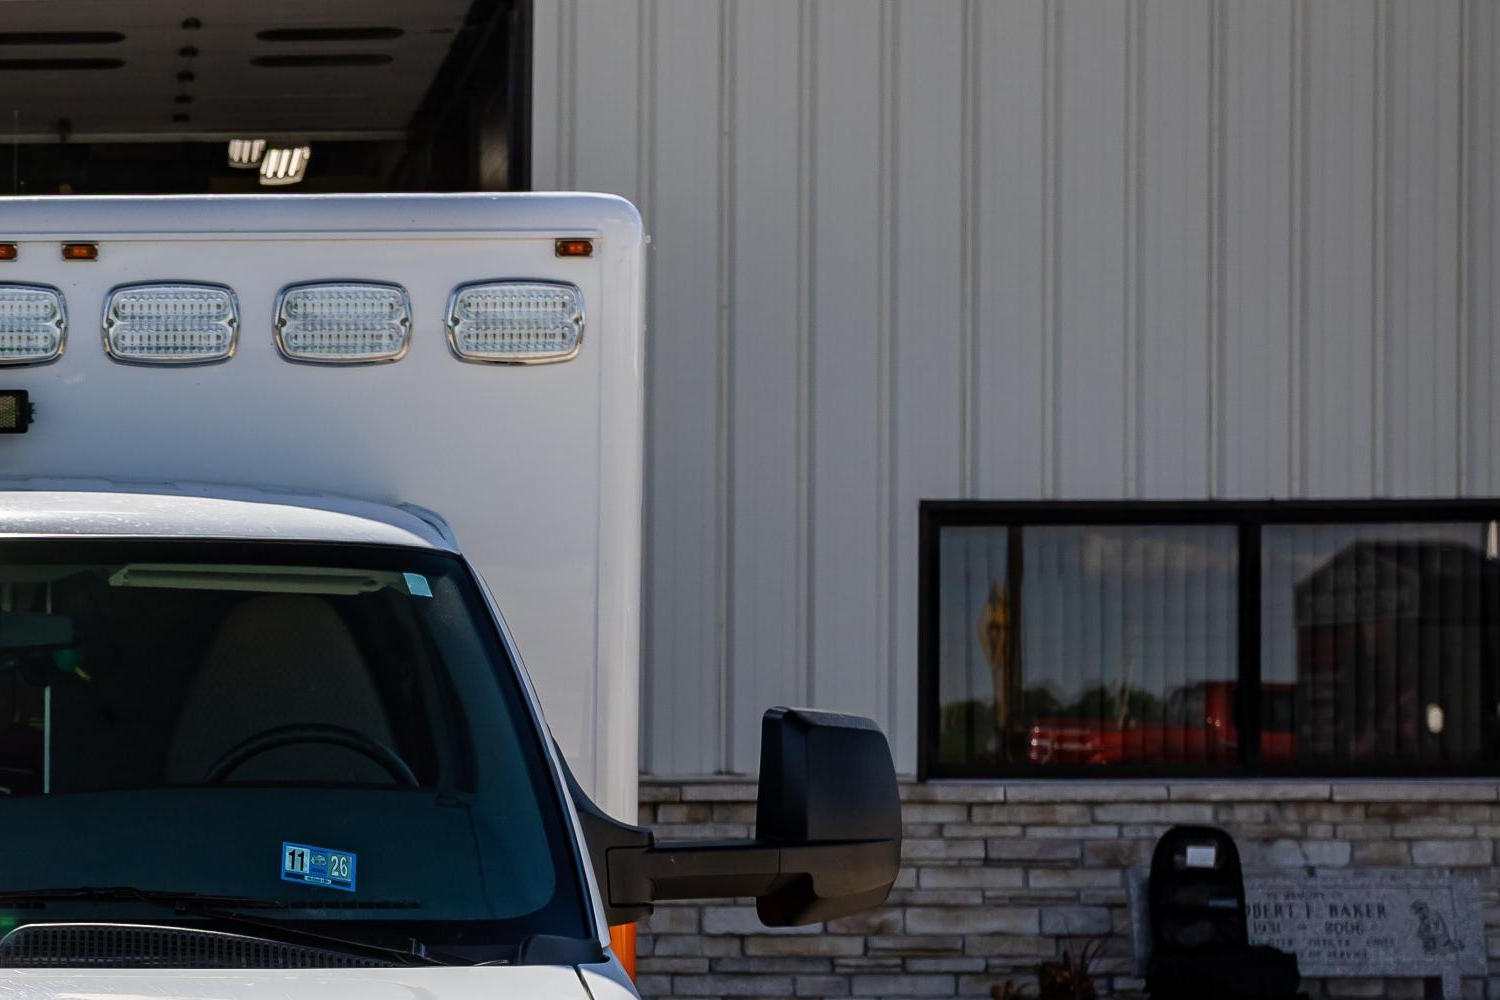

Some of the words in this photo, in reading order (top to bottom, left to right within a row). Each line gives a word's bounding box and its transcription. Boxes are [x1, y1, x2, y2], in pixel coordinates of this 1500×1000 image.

[288, 849, 305, 872] 11
[330, 855, 348, 878] 26
[1328, 902, 1387, 919] BAKER
